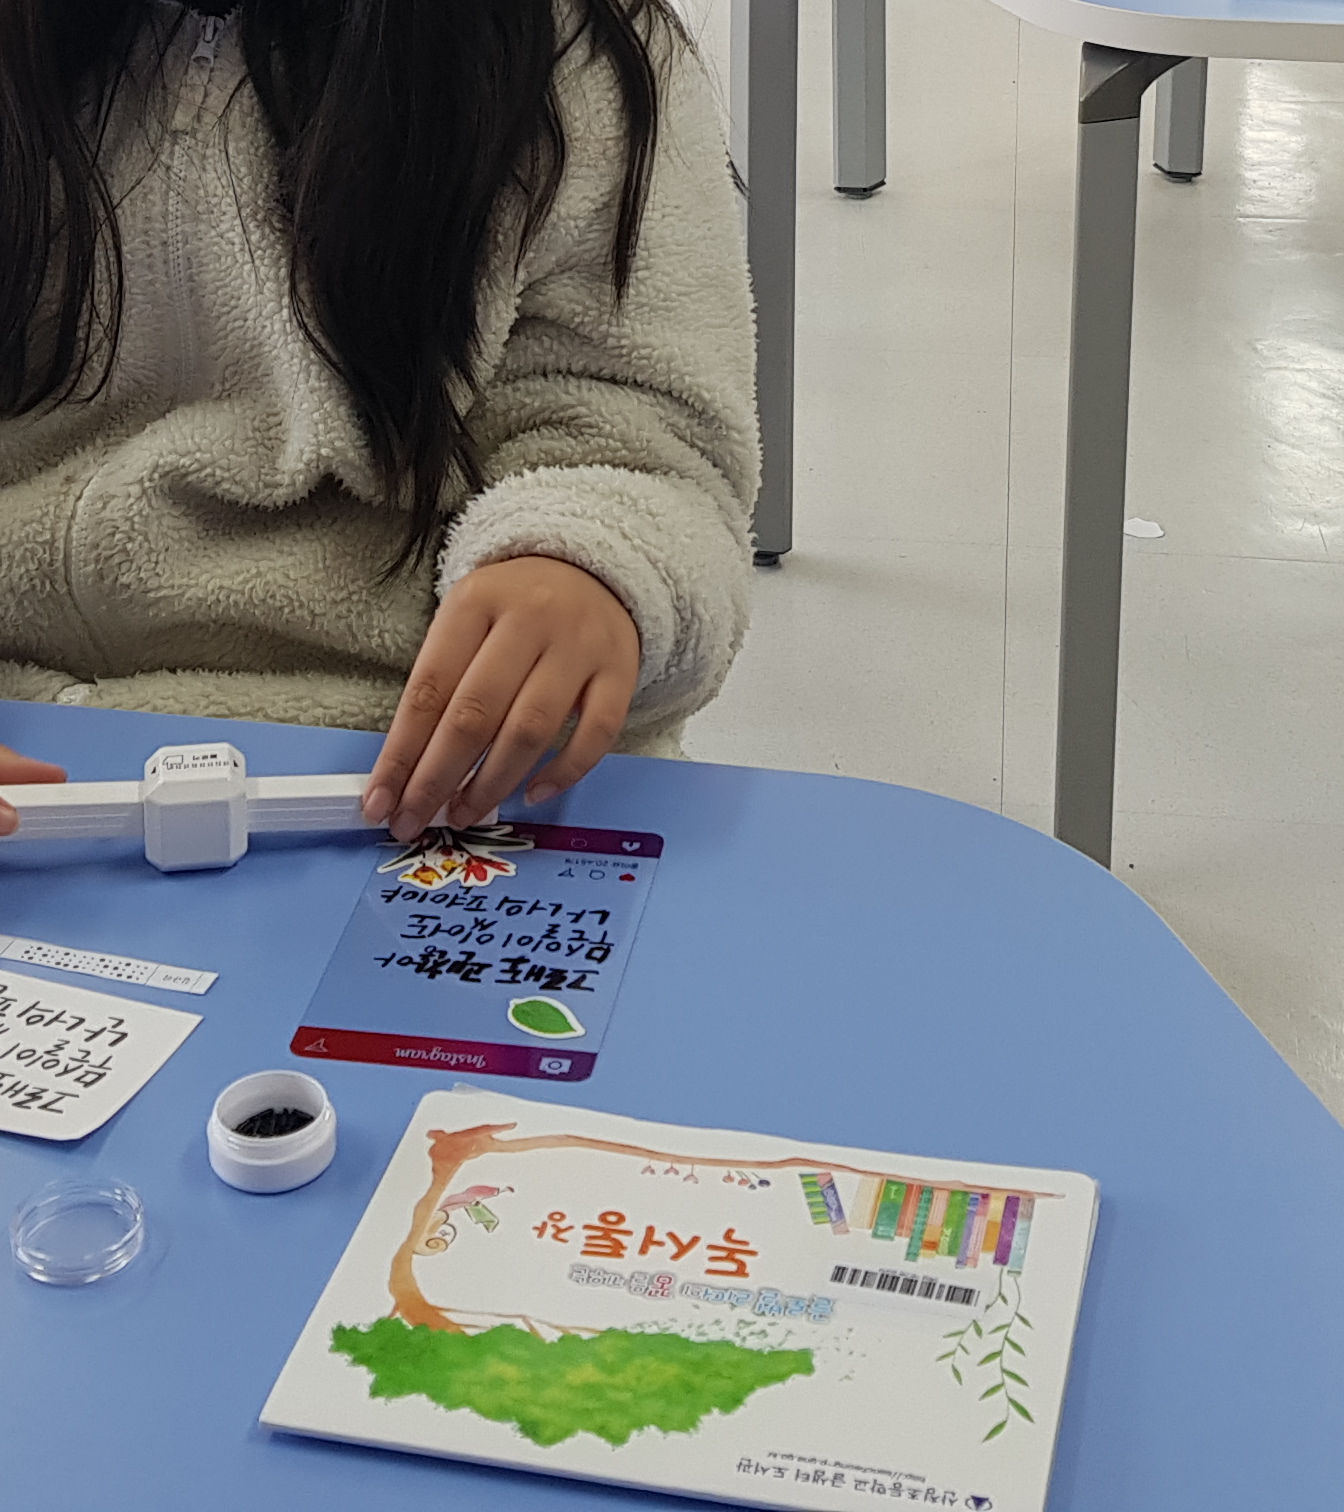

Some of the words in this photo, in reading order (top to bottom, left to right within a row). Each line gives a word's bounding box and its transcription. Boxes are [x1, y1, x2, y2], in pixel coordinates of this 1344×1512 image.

[494, 896, 563, 919] 너의
[399, 913, 498, 948] 있어도
[495, 956, 599, 993] 그래도
[16, 998, 86, 1033] 너의
[84, 1016, 129, 1048] 난
[394, 1046, 487, 1070] Instagram
[531, 1211, 759, 1279] 독서통장
[627, 1272, 676, 1301] 꿈을
[680, 1282, 754, 1307] 리더의
[754, 1289, 835, 1324] 글로벌
[735, 1457, 790, 1480] 도서관
